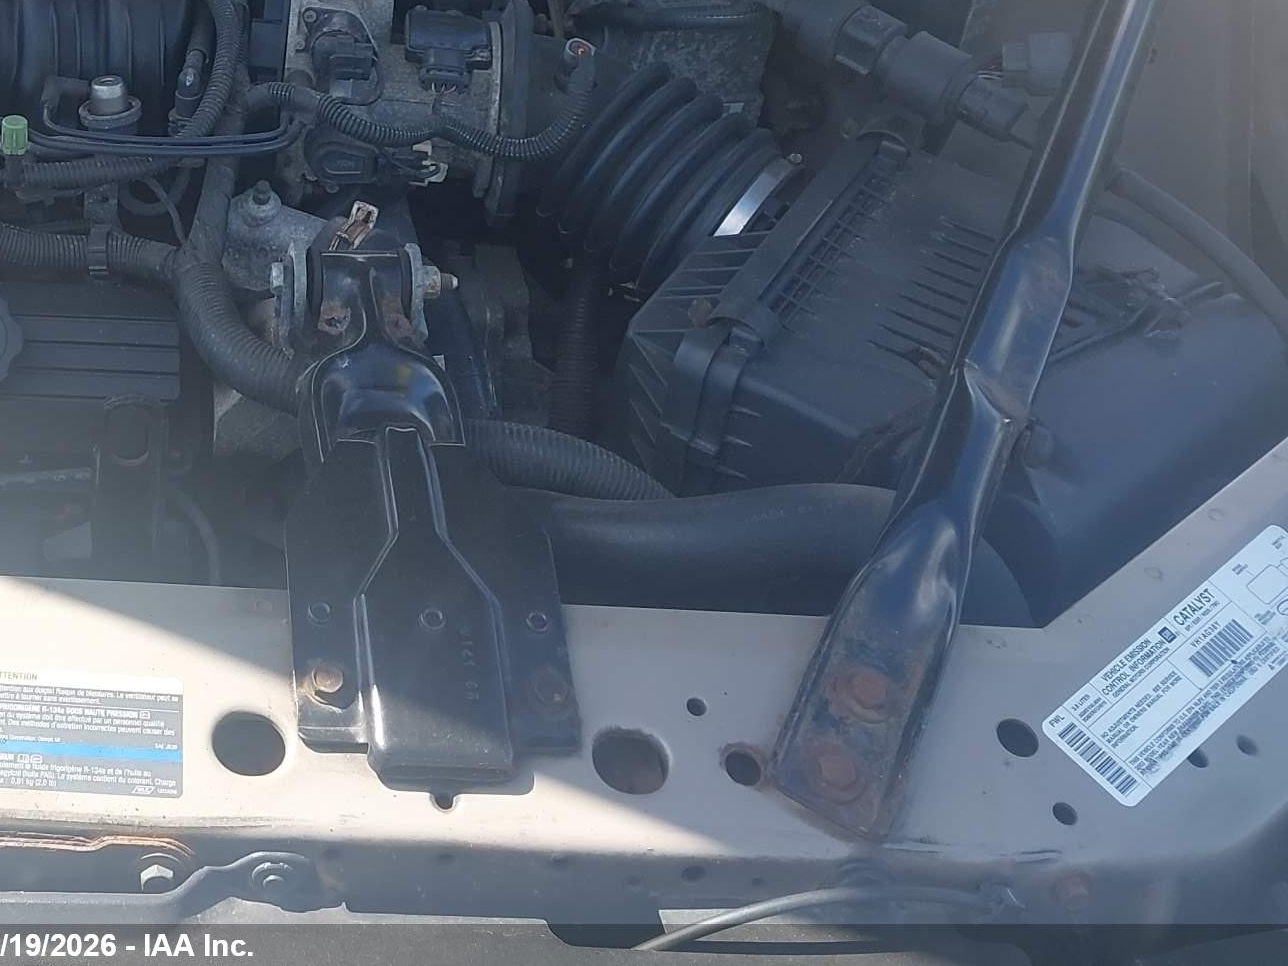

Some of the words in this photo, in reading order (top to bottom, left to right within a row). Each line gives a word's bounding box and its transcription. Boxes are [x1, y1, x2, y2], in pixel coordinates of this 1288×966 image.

[1171, 588, 1217, 626] CATALYST
[1100, 658, 1127, 682] VEHICLE
[1123, 637, 1152, 662] EMISSION
[1100, 669, 1131, 696] CONTROL
[1127, 638, 1168, 673] INFORMATION
[1110, 680, 1131, 698] GENERAL
[1128, 667, 1146, 683] MOTORS
[1143, 646, 1172, 670] CORPORATION
